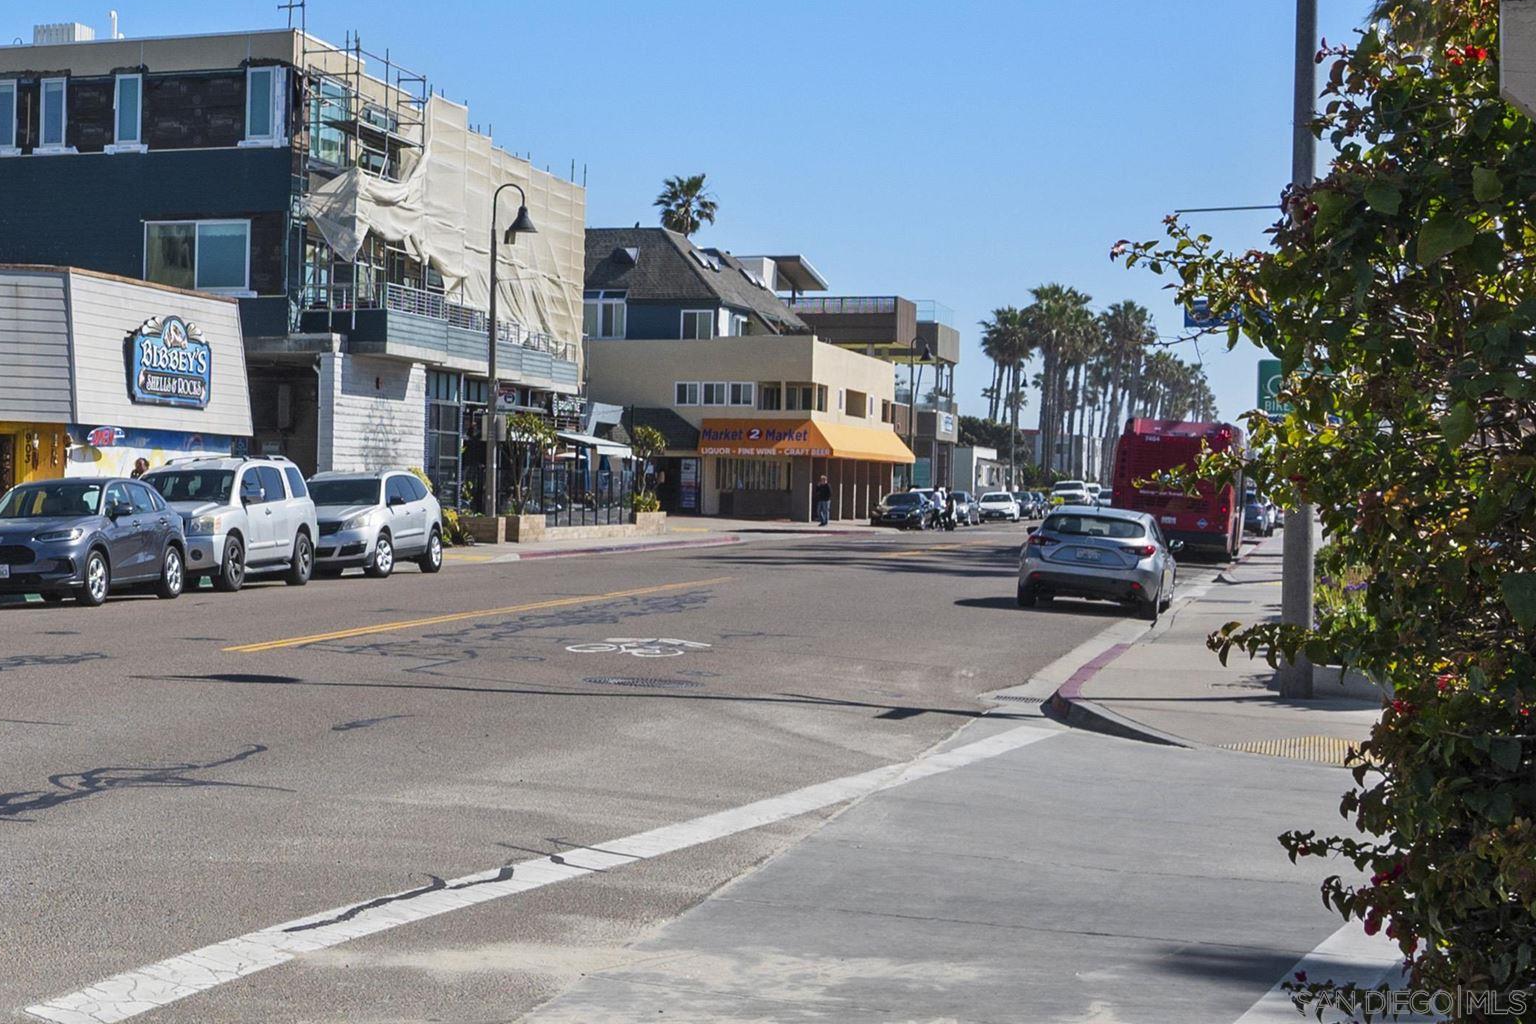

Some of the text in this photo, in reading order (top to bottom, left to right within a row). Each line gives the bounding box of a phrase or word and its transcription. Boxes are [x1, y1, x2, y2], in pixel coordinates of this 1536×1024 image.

[141, 340, 206, 373] BIBBEY'S
[146, 375, 170, 391] SHELLS
[178, 378, 202, 396] ROCKS
[1264, 401, 1290, 411] BIKE
[702, 428, 808, 442] Market 2 Market
